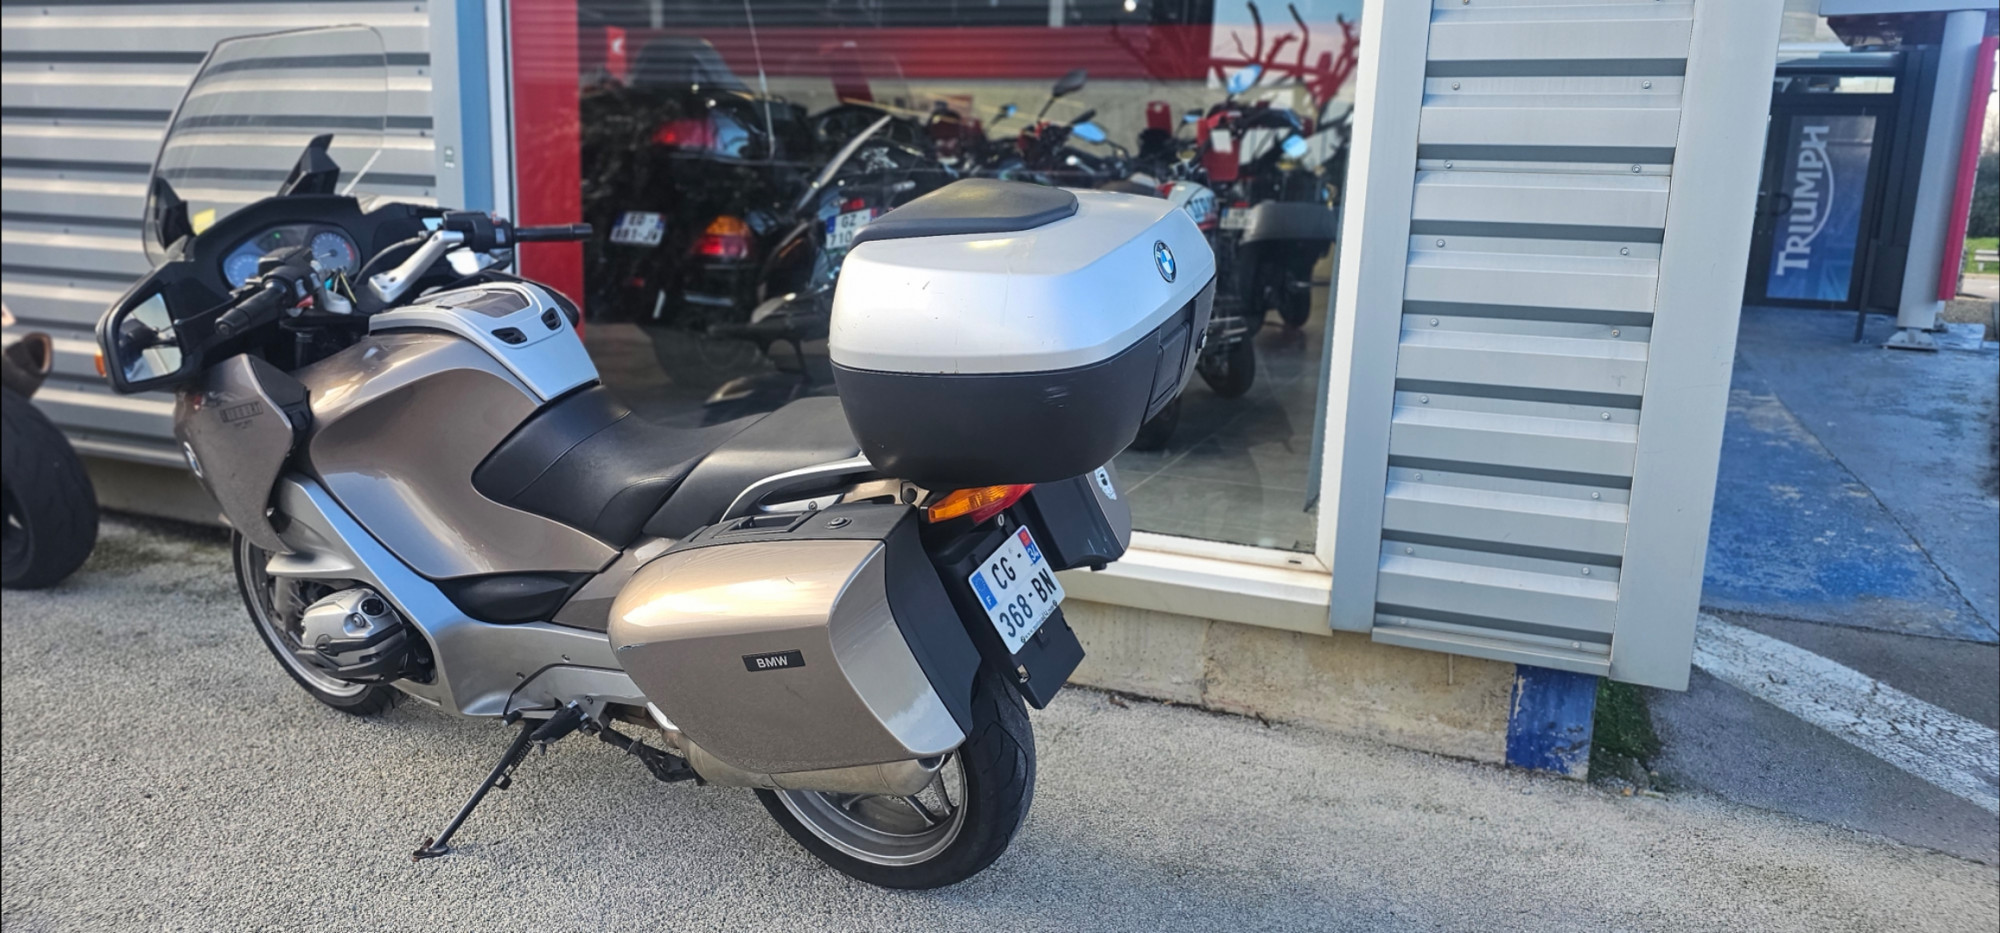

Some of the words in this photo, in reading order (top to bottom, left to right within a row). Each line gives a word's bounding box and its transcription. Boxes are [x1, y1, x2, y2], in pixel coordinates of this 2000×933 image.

[841, 214, 857, 228] GZ
[1775, 126, 1830, 275] TRIUMPH
[999, 567, 1057, 638] 368-BN
[755, 655, 788, 668] BMW
